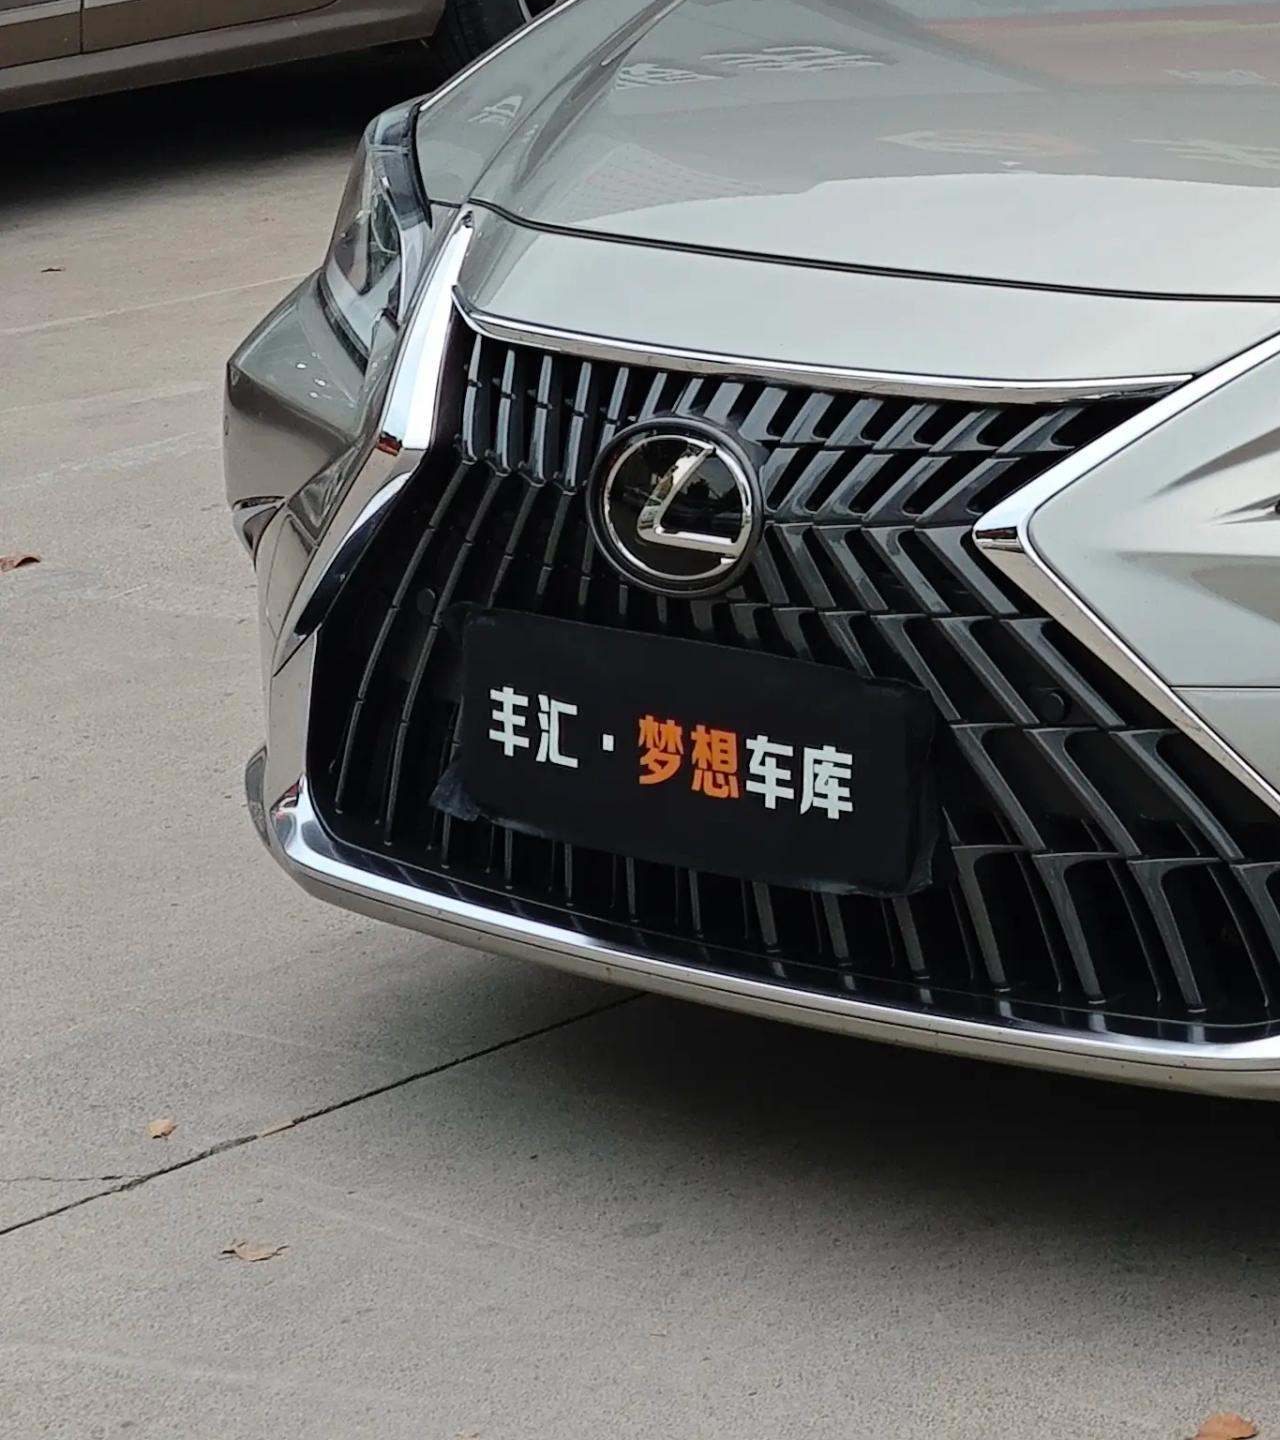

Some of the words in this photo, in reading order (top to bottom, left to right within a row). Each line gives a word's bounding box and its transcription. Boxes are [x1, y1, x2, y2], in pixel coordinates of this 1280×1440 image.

[488, 685, 854, 820] 丰汇·梦想车库
